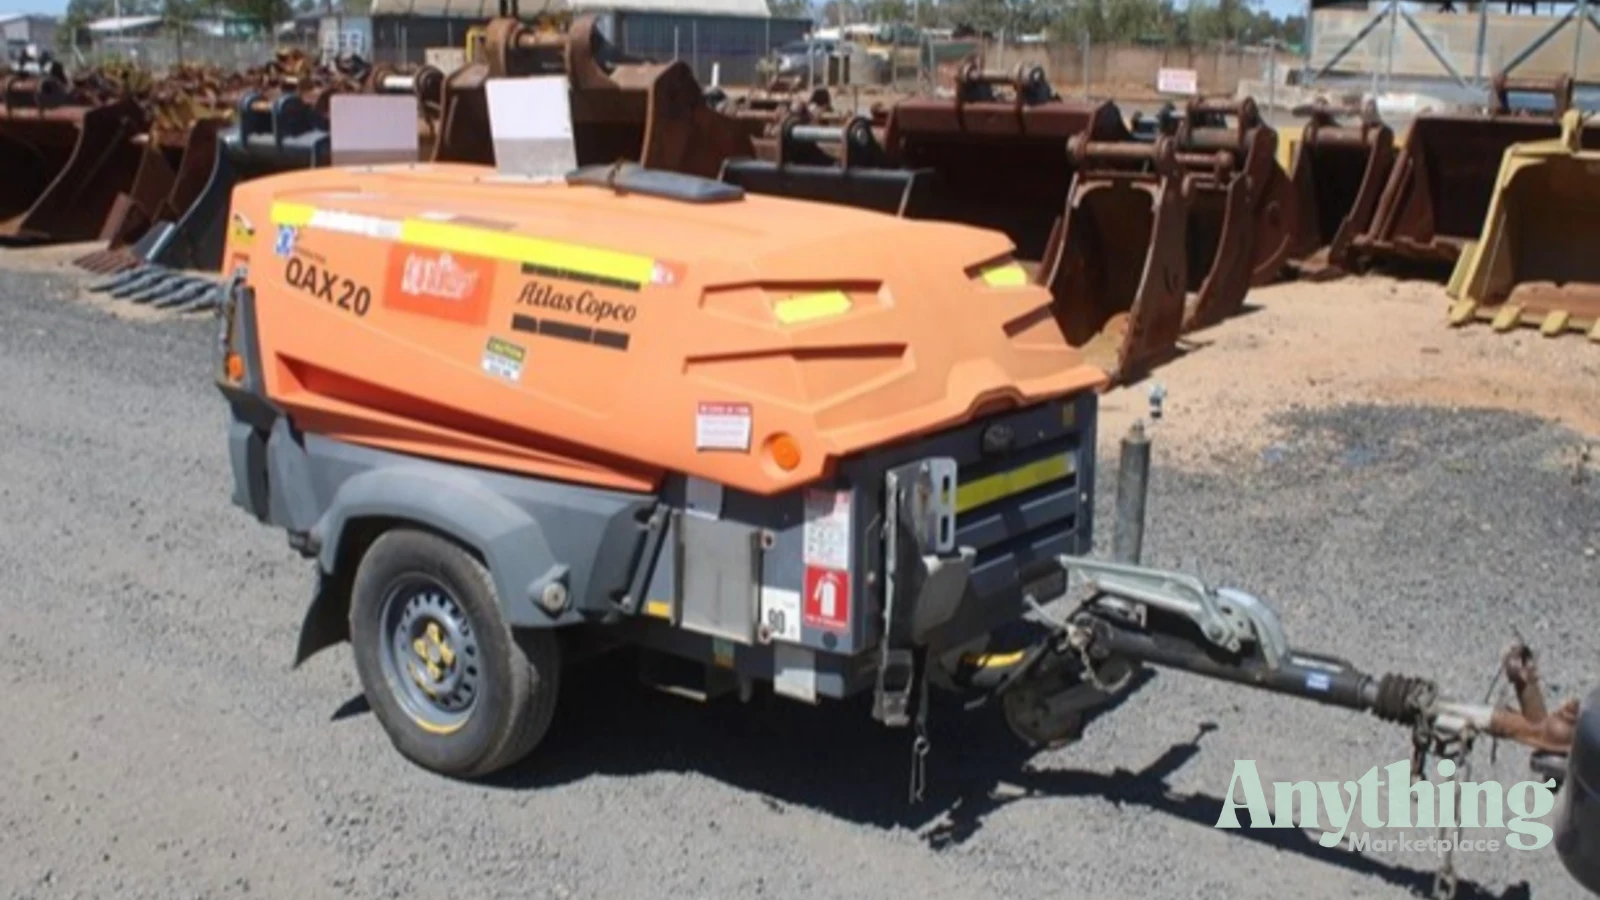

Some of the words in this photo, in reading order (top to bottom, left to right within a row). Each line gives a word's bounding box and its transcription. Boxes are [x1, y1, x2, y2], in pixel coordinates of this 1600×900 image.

[285, 256, 338, 303] QAX
[336, 278, 371, 316] 20
[517, 281, 574, 313] Atlas
[575, 289, 637, 323] Copco
